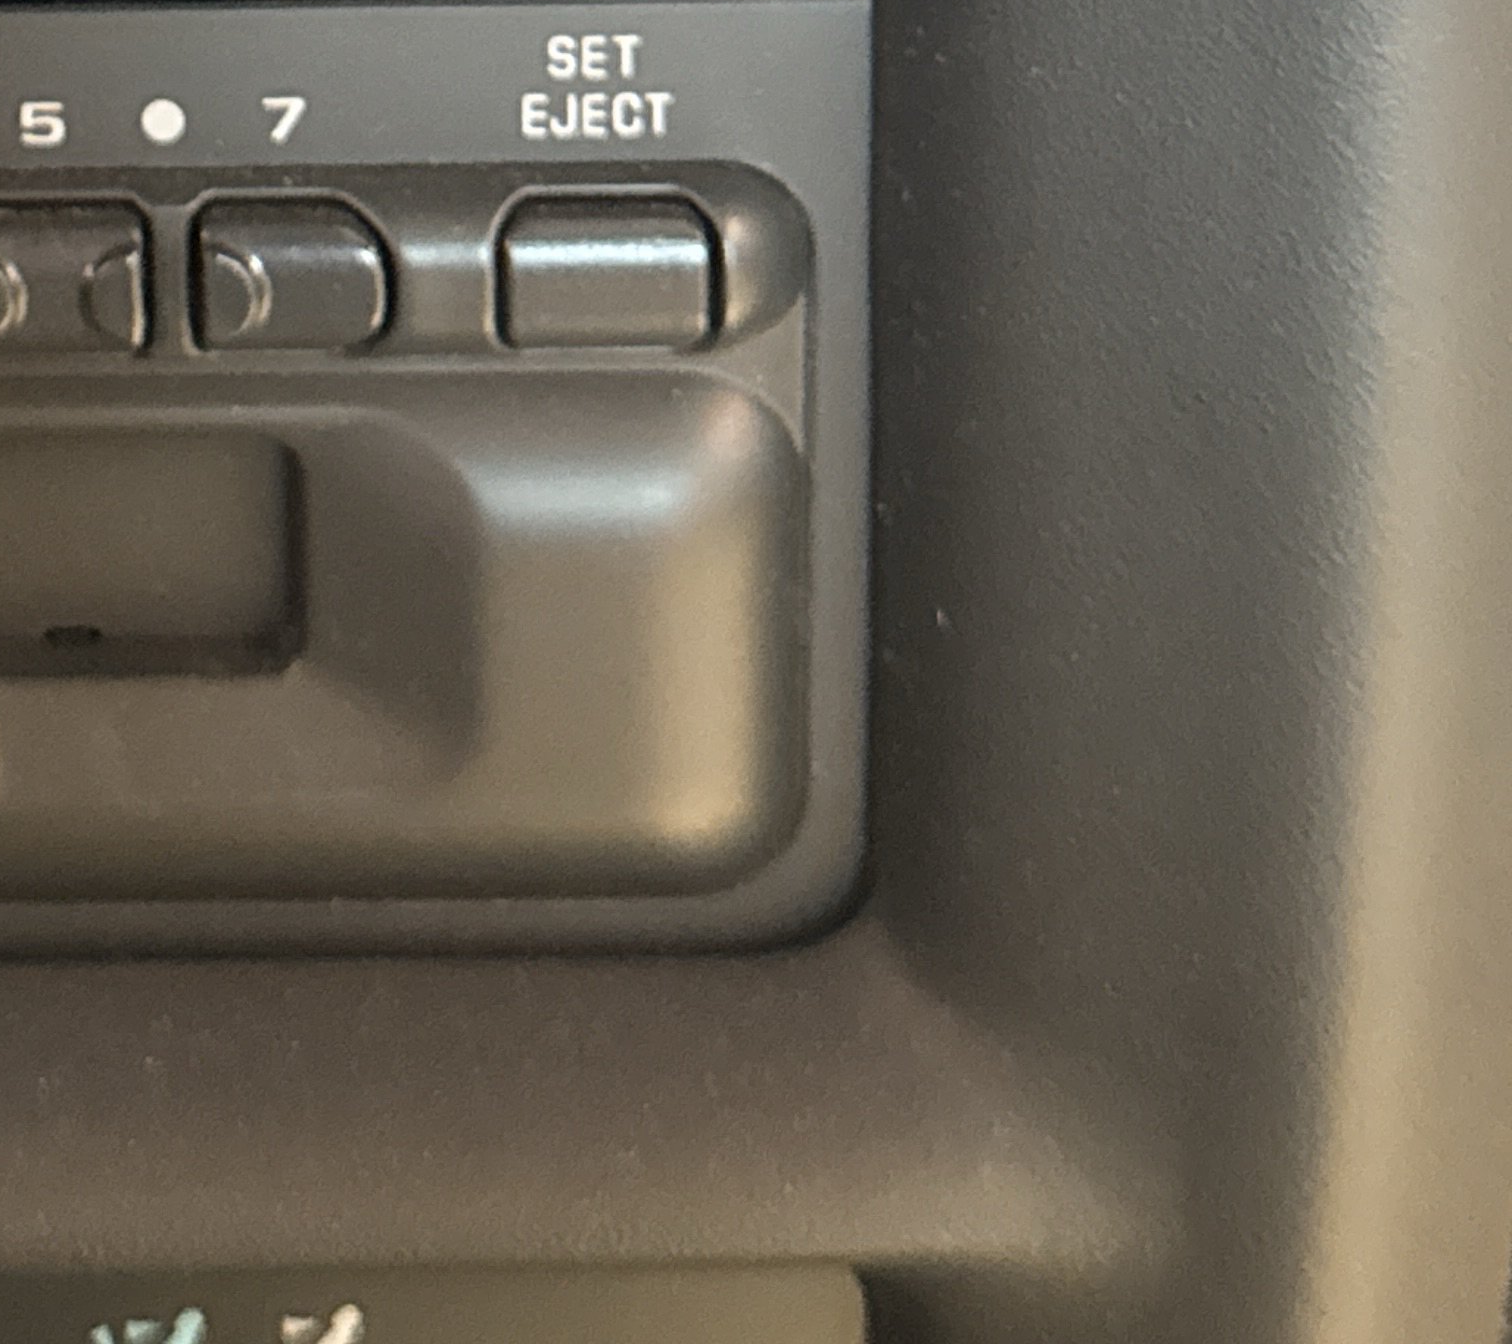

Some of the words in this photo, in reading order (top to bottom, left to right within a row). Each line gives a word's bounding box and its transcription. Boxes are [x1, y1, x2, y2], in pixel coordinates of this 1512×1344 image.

[545, 33, 643, 81] SET
[19, 100, 67, 148] 5
[261, 96, 307, 144] 7
[519, 90, 676, 141] EJECT
